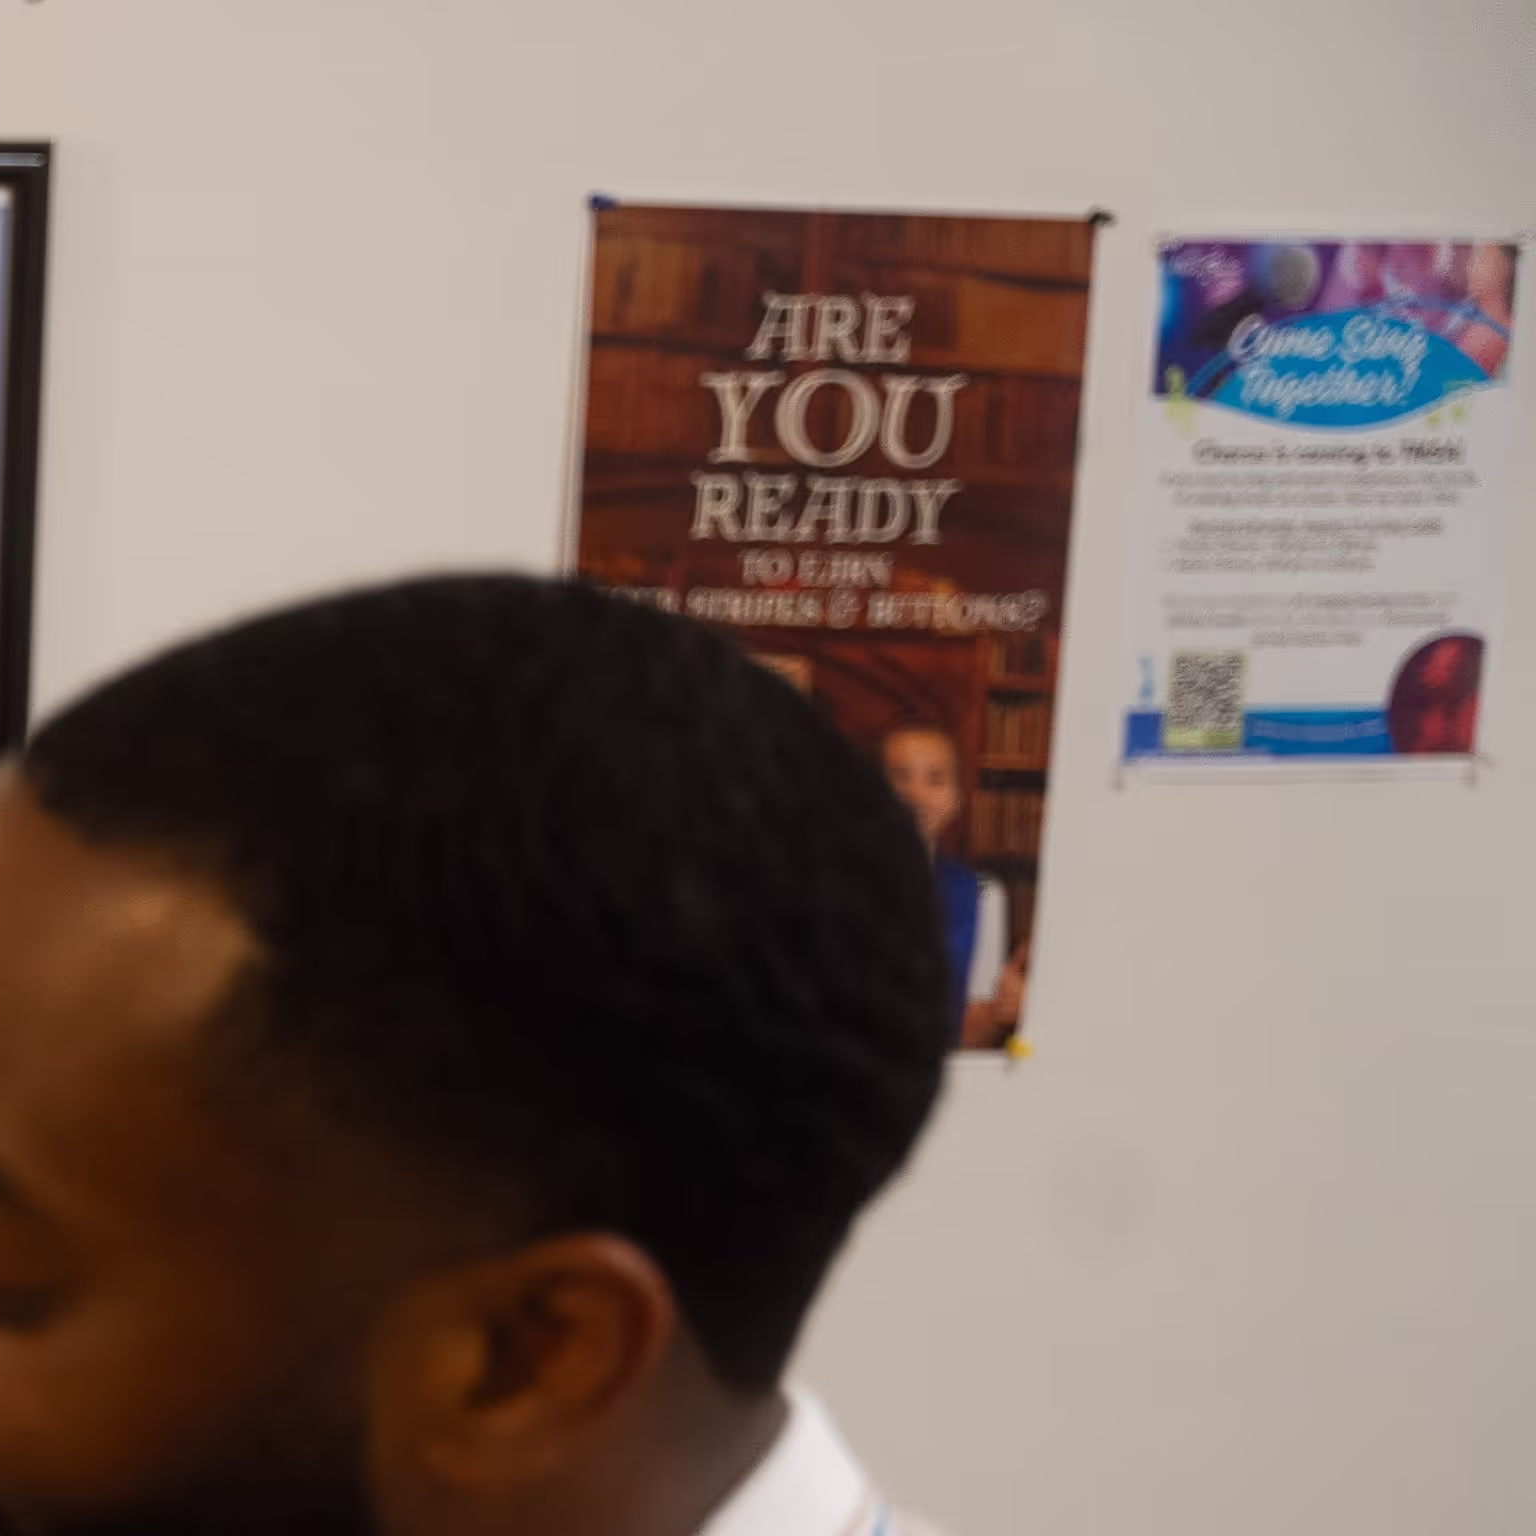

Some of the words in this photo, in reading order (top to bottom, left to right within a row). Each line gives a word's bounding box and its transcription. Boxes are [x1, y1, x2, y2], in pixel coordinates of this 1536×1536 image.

[745, 292, 916, 366] ARE
[1341, 314, 1428, 378] Sing
[698, 367, 967, 470] YOU
[689, 472, 962, 544] READY
[738, 549, 795, 586] TO
